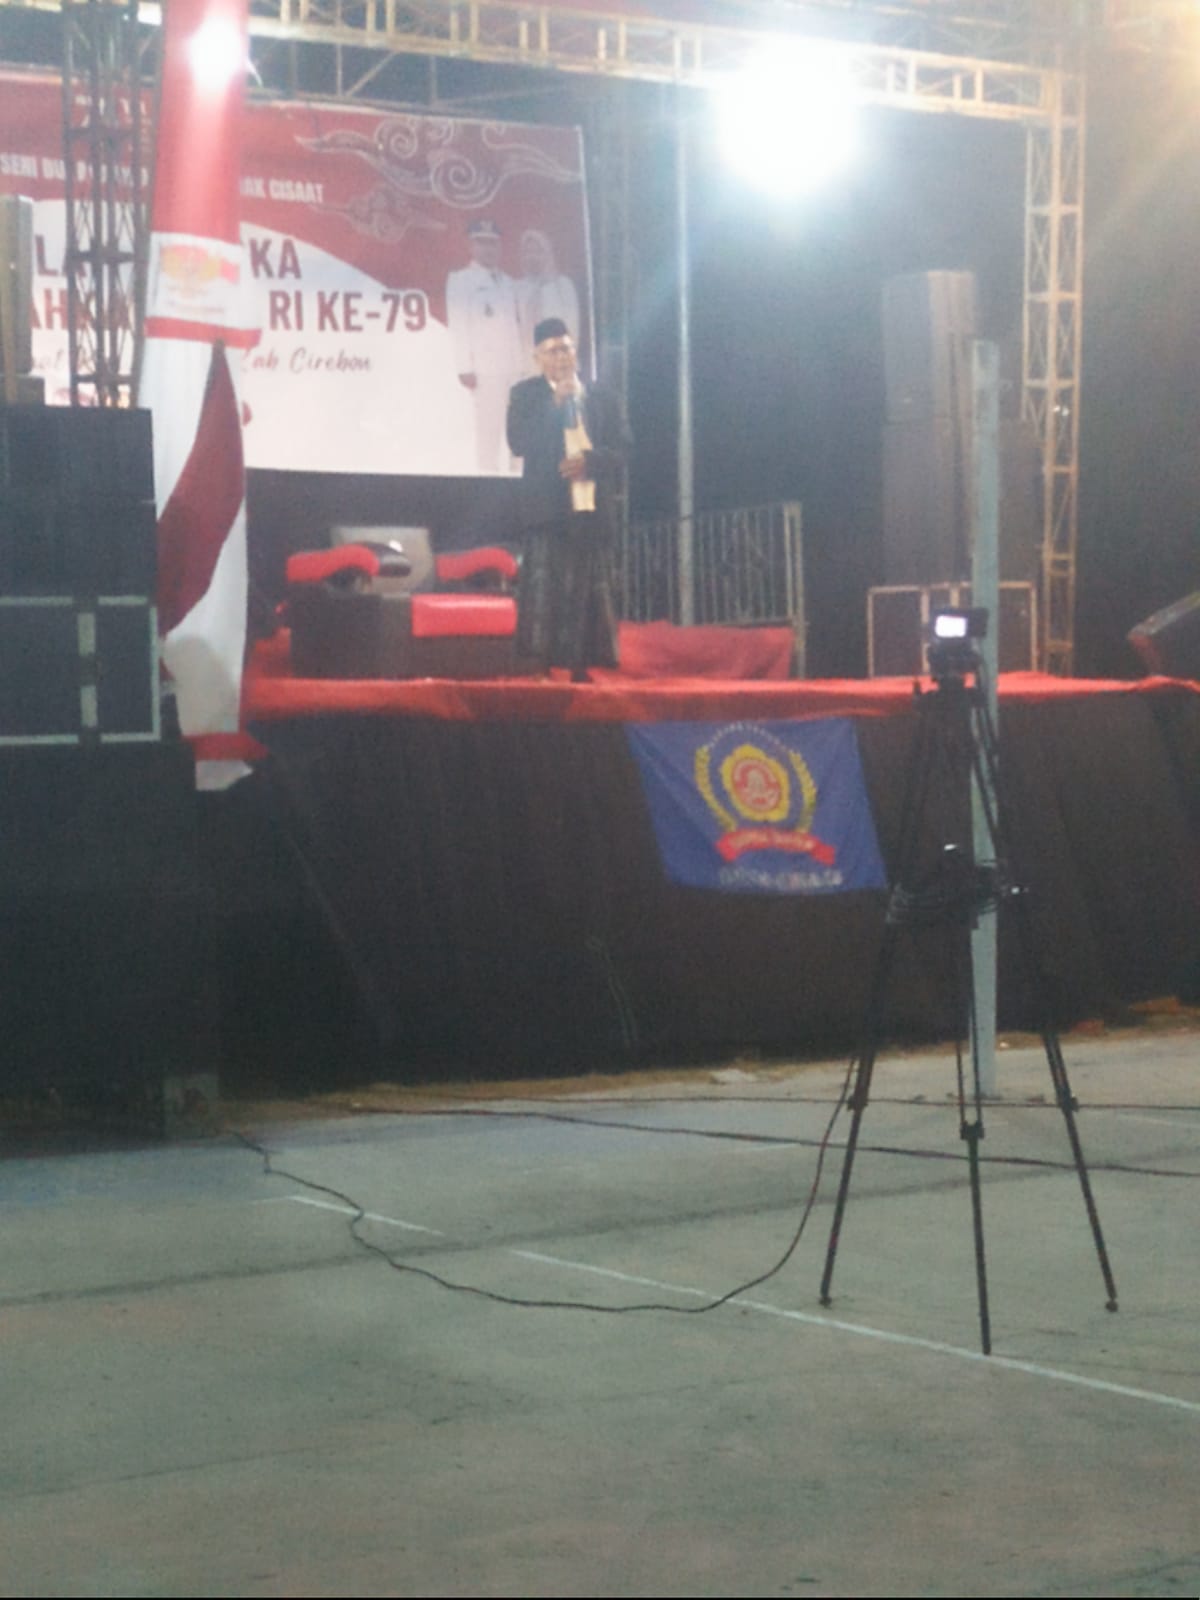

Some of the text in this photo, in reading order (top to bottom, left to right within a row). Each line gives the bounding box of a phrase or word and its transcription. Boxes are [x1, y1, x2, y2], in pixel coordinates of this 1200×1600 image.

[269, 290, 303, 332] RI
[317, 290, 427, 333] KE-79
[289, 345, 372, 374] Cirebon
